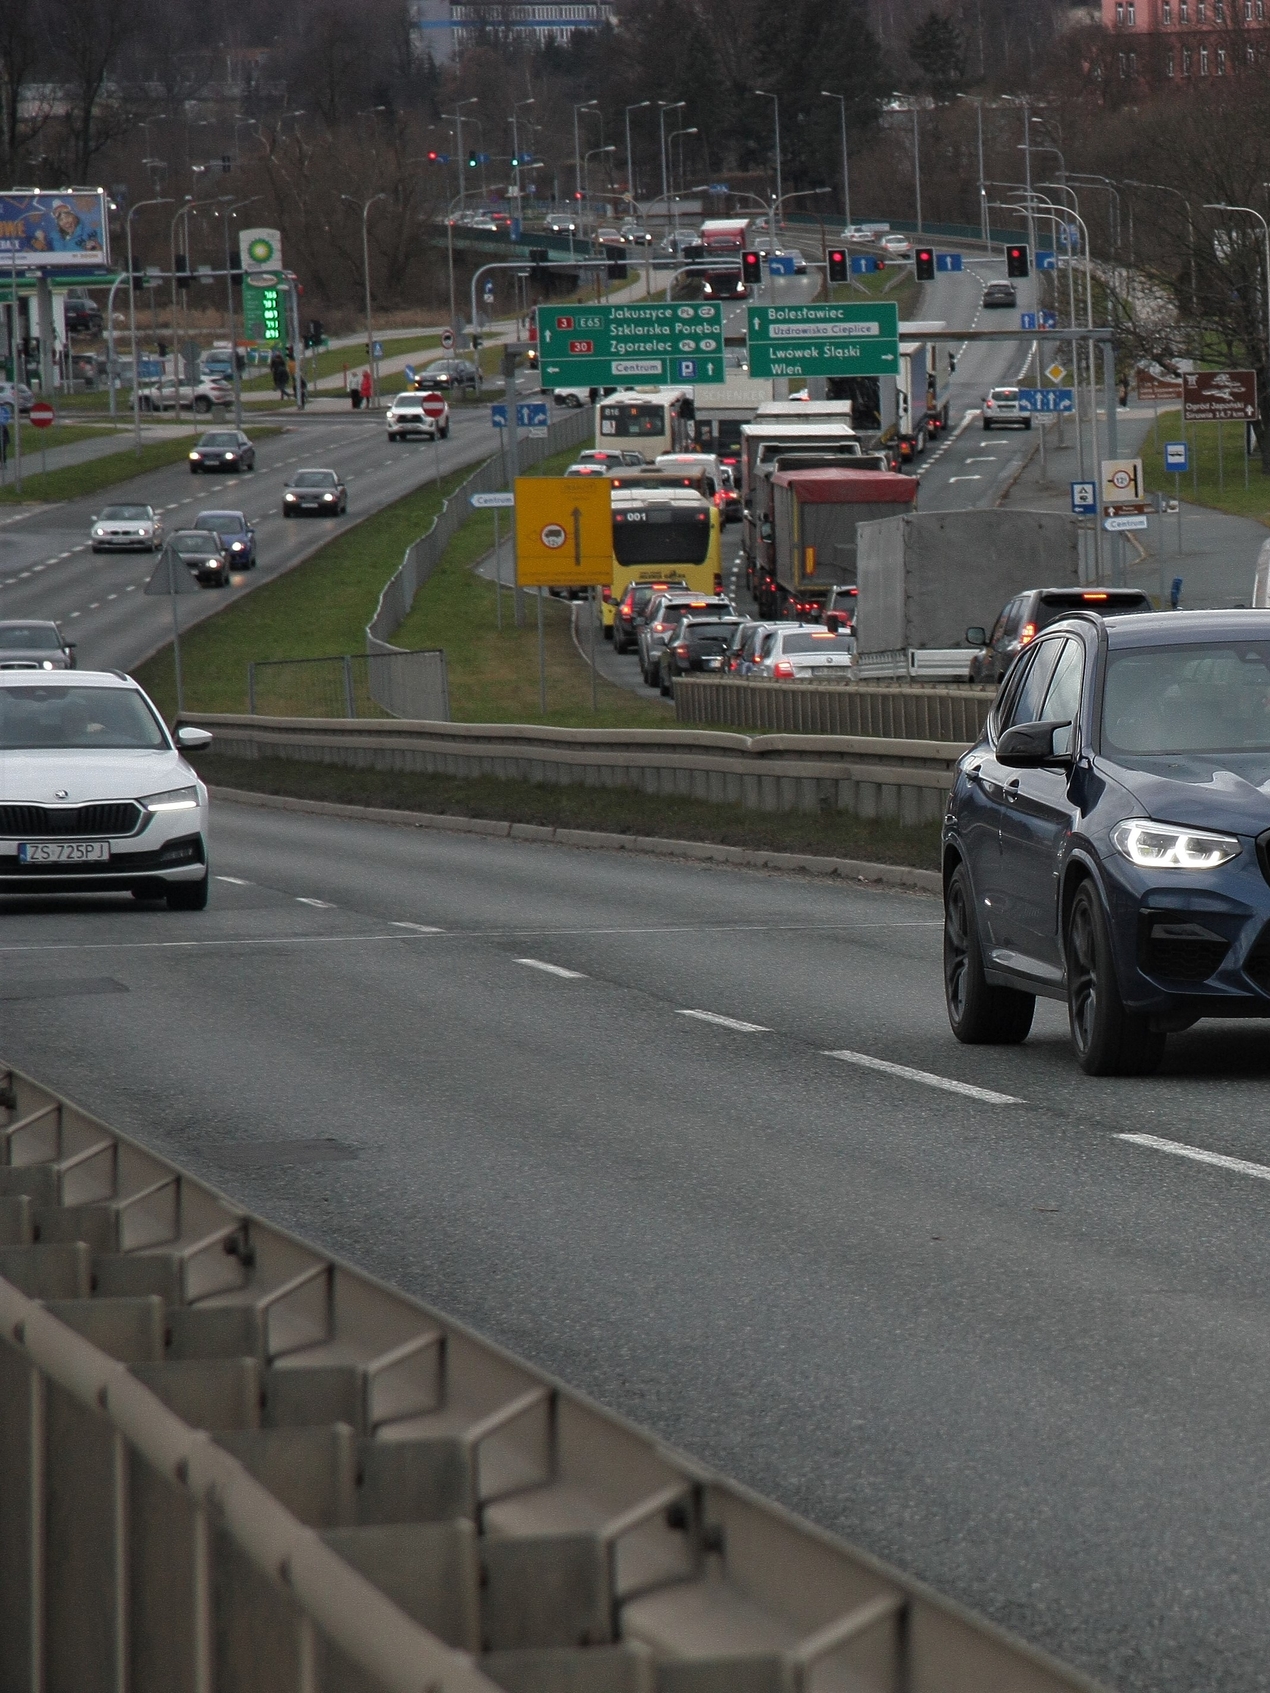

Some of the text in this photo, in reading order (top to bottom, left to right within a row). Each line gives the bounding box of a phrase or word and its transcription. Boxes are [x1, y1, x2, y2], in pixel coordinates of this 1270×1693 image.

[609, 307, 673, 320] Jakuszyce
[680, 308, 692, 317] PL
[768, 307, 844, 320] Bolesławiec
[560, 317, 600, 328] 3 E65
[610, 323, 721, 336] Szklarska Poręba
[773, 324, 873, 337] Uzdrowisko Cieplice
[574, 341, 588, 352] 30
[610, 340, 673, 354] Zgorzelec
[681, 341, 693, 349] PL
[769, 342, 861, 360] Lwówek Śląski
[615, 362, 660, 373] Centrum
[771, 362, 802, 375] Wleń
[1186, 402, 1210, 411] Ogród
[1232, 410, 1245, 418] km
[477, 496, 513, 504] Centrum
[627, 512, 647, 521] 001
[1110, 520, 1146, 529] Centrum
[30, 844, 104, 860] ZS 725PJ
